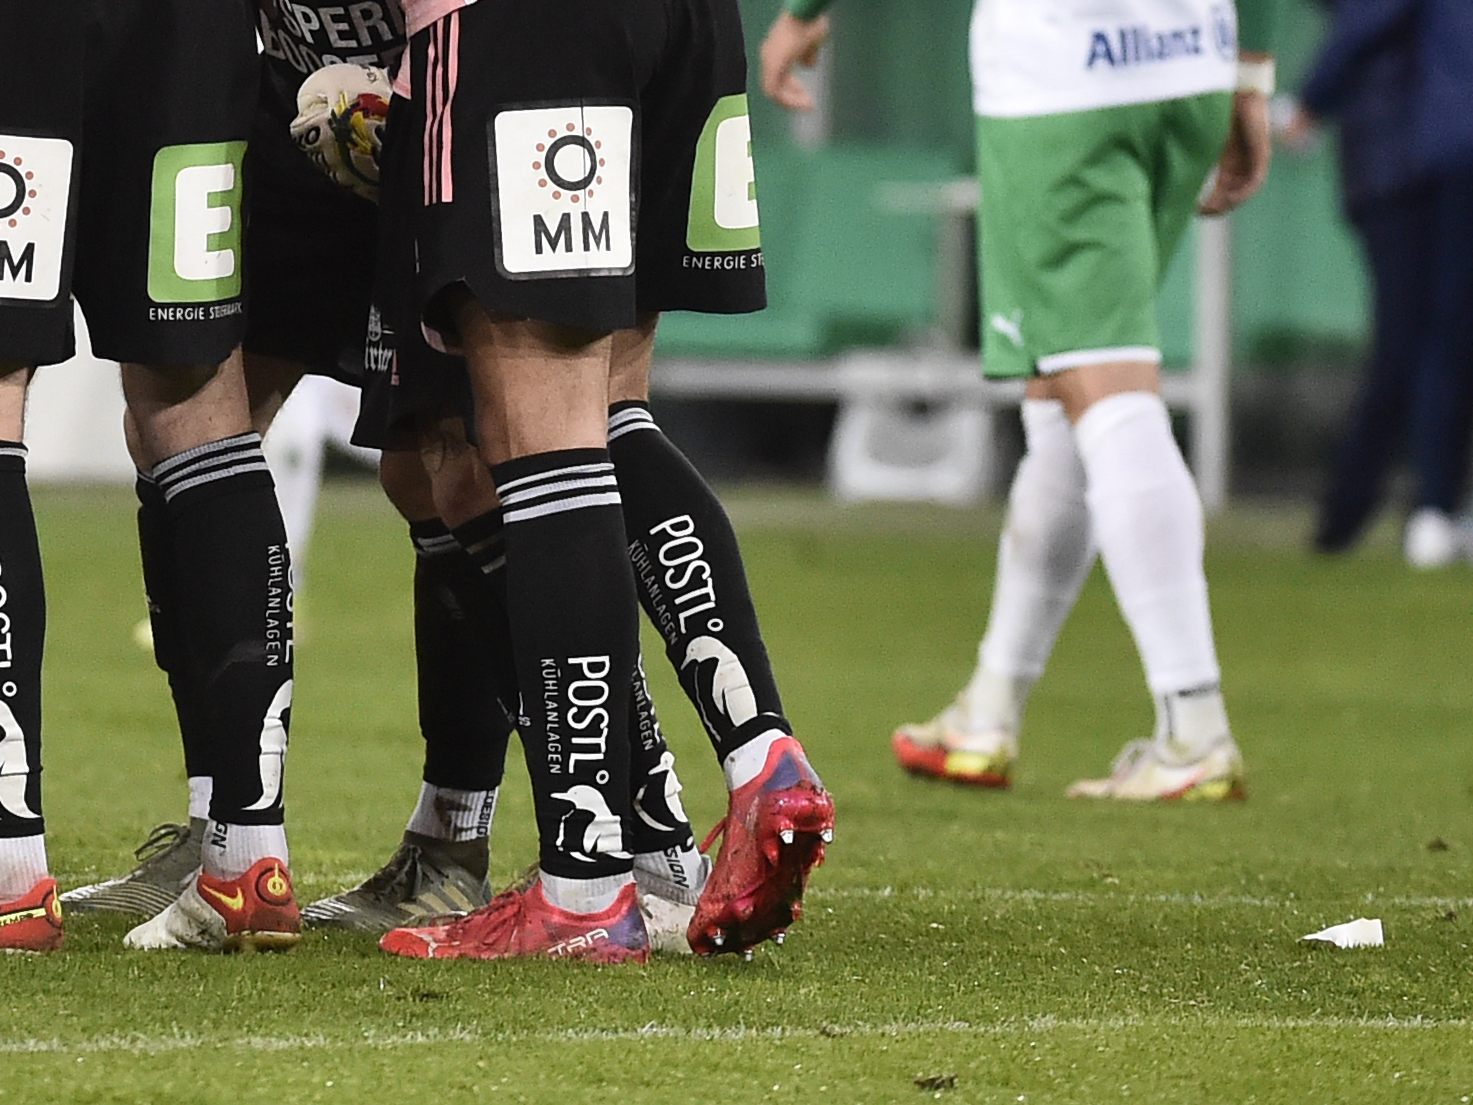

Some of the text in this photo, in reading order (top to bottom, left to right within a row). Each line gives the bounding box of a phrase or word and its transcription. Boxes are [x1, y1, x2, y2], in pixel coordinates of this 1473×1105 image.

[1087, 23, 1203, 71] Allianz
[174, 163, 235, 280] E
[533, 210, 611, 256] MM
[682, 254, 747, 271] ENERGIE
[149, 307, 205, 321] ENERGIE
